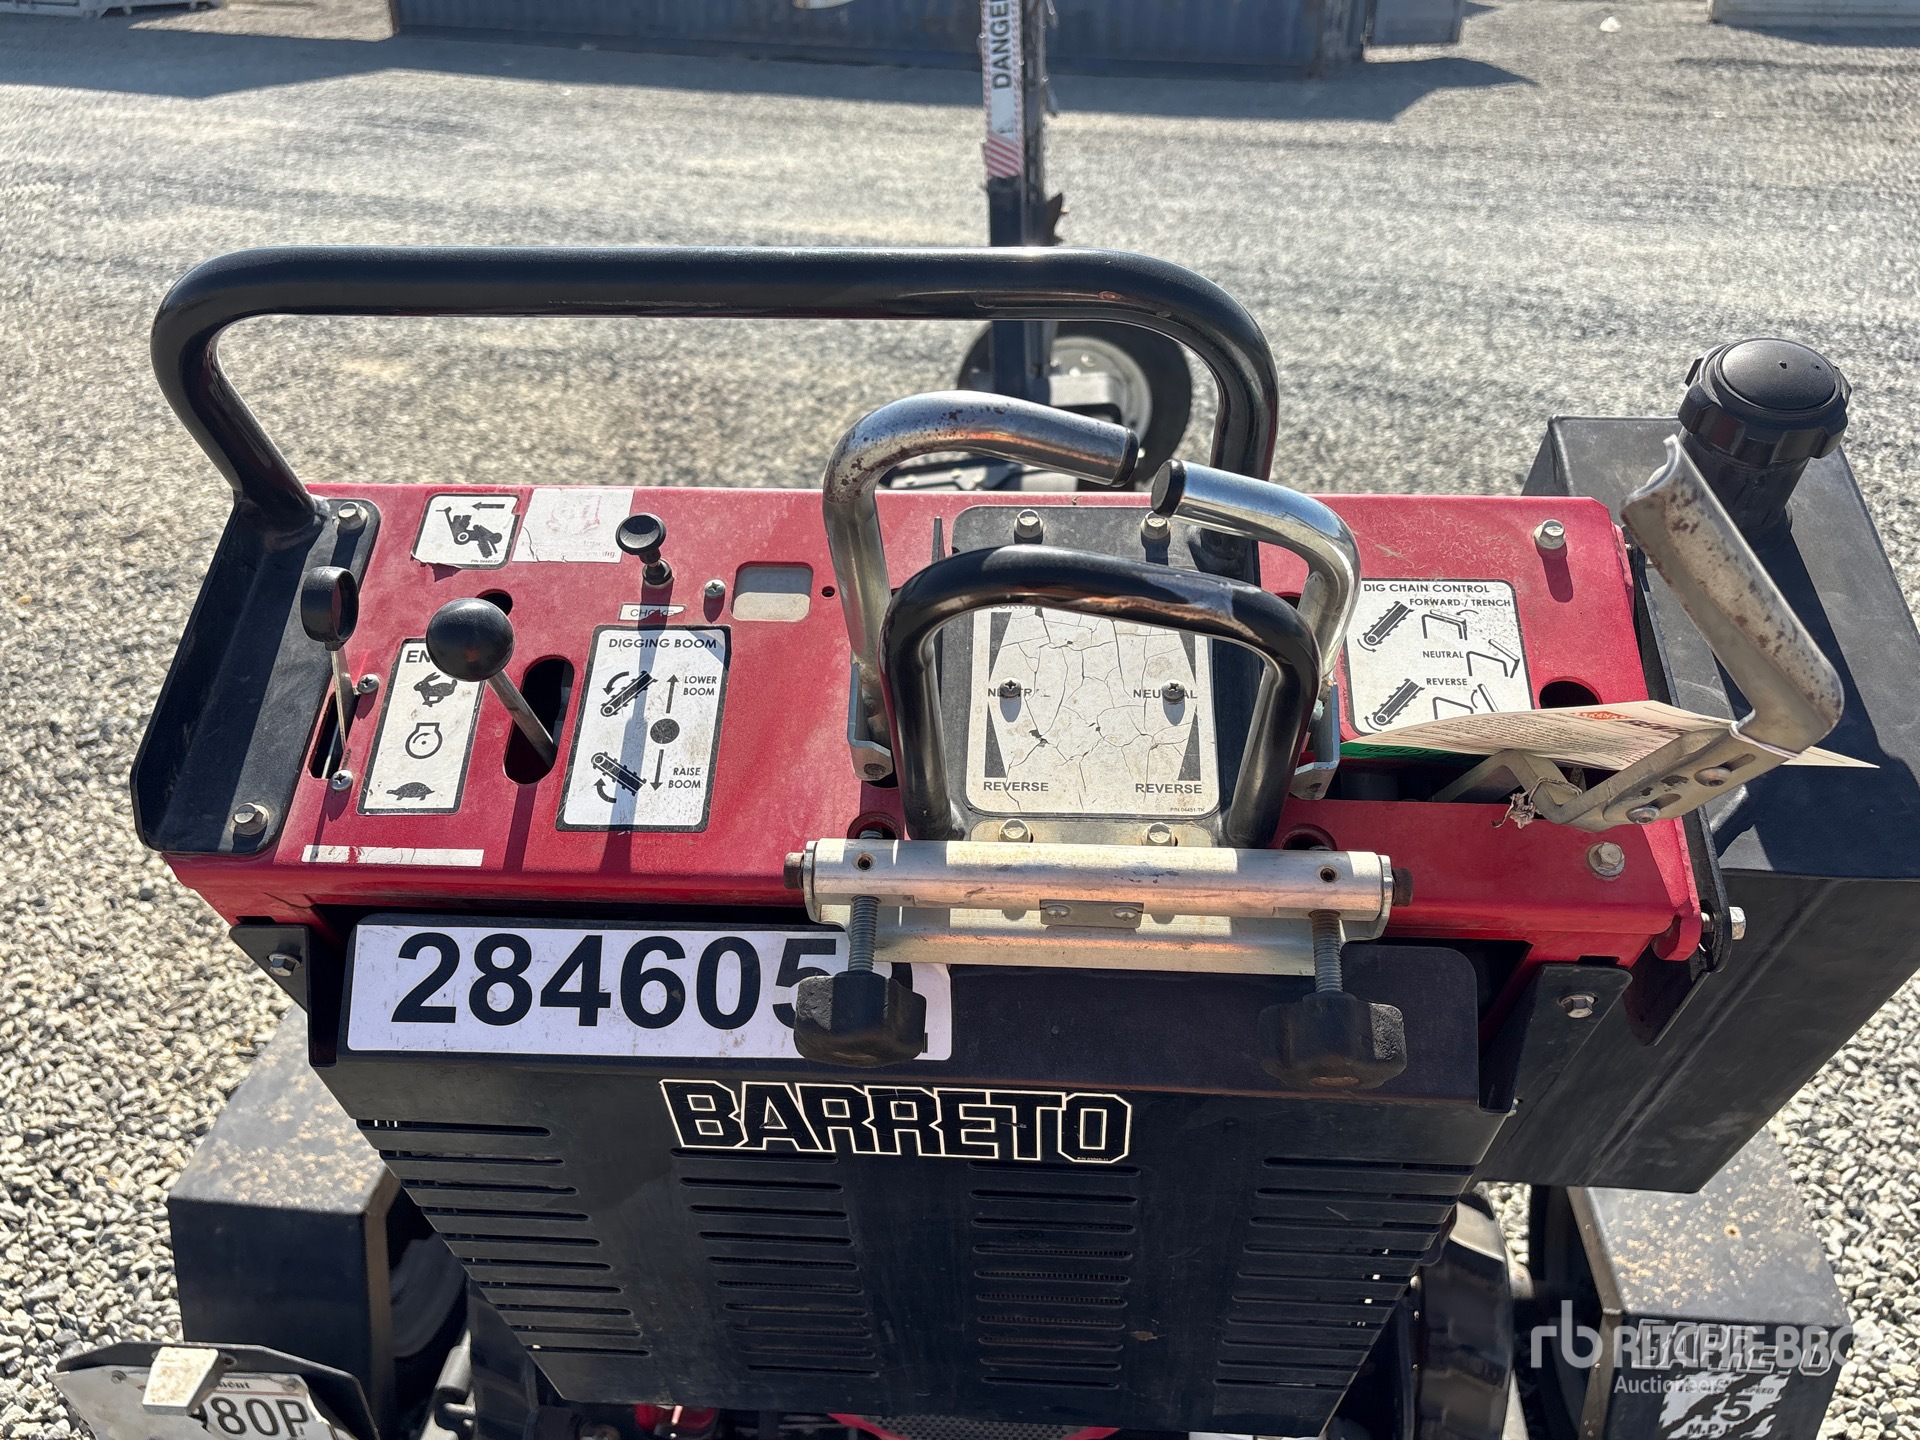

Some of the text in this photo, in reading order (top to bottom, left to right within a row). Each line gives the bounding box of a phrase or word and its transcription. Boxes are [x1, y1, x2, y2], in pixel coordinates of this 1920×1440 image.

[989, 0, 1012, 90] DANGE
[1363, 583, 1491, 593] DIG CHAIN CONTROL
[1409, 598, 1461, 606] FORWARD
[1471, 599, 1511, 607] TRENCH
[608, 638, 717, 648] DIGGING BOOM
[1422, 650, 1465, 659] NEUTRAL
[684, 675, 718, 684] LOWER
[1426, 677, 1468, 686] REVERSE
[683, 687, 715, 696] BOOM
[1133, 689, 1198, 699] NEUAL
[672, 767, 702, 776] RAISE
[668, 779, 702, 789] BOOM
[983, 781, 1049, 792] REVERSE
[1135, 783, 1203, 794] REVERSE
[391, 931, 912, 1032] 284605
[659, 1078, 1132, 1163] BARRETO
